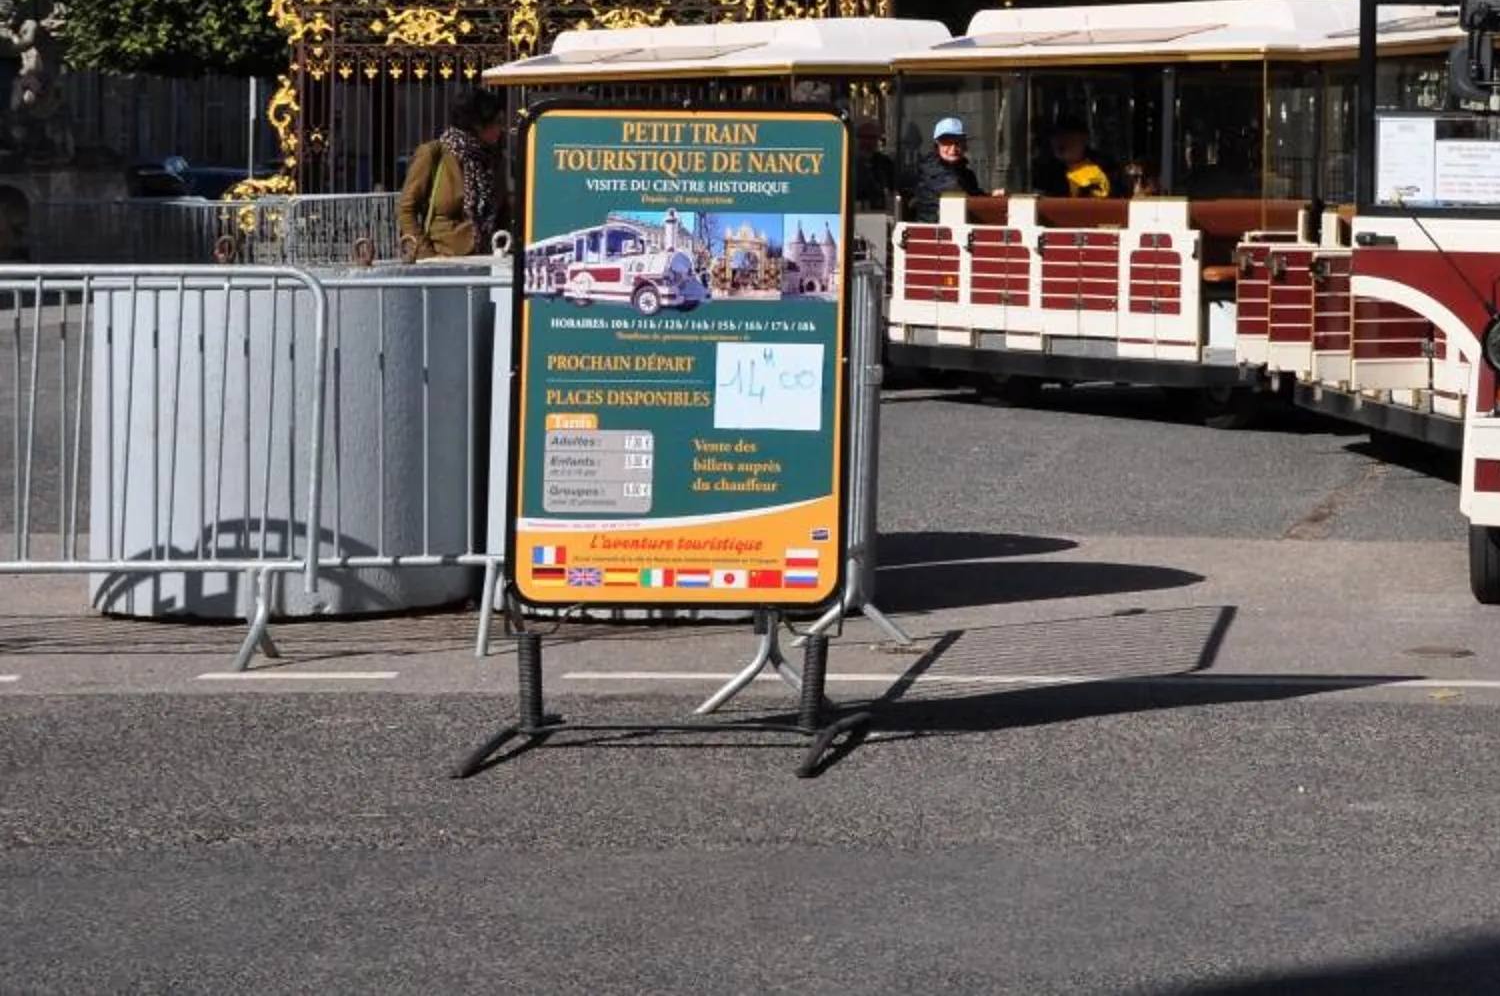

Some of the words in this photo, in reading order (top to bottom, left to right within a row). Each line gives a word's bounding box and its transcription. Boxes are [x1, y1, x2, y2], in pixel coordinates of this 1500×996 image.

[621, 121, 687, 143] PETIT
[690, 122, 760, 145] TRAIN
[554, 149, 707, 176] TOURISTIQUE
[711, 152, 743, 173] DE
[748, 152, 825, 174] NANCY
[586, 178, 628, 191] VISITE
[631, 179, 651, 191] DU
[653, 179, 705, 192] CENTRE
[708, 180, 790, 195] HISTORIQUE
[547, 355, 631, 372] PROCHAIN
[635, 352, 696, 373] DÉPART
[546, 389, 604, 406] PLACES
[607, 390, 711, 407] DISPONIBLES
[693, 438, 731, 453] Vente
[734, 438, 757, 453] des
[693, 457, 734, 473] billets
[738, 459, 782, 476] auprès
[692, 477, 711, 491] du
[713, 477, 777, 492] chauffeur
[589, 533, 677, 551] L'aventure
[677, 537, 763, 555] touristique
